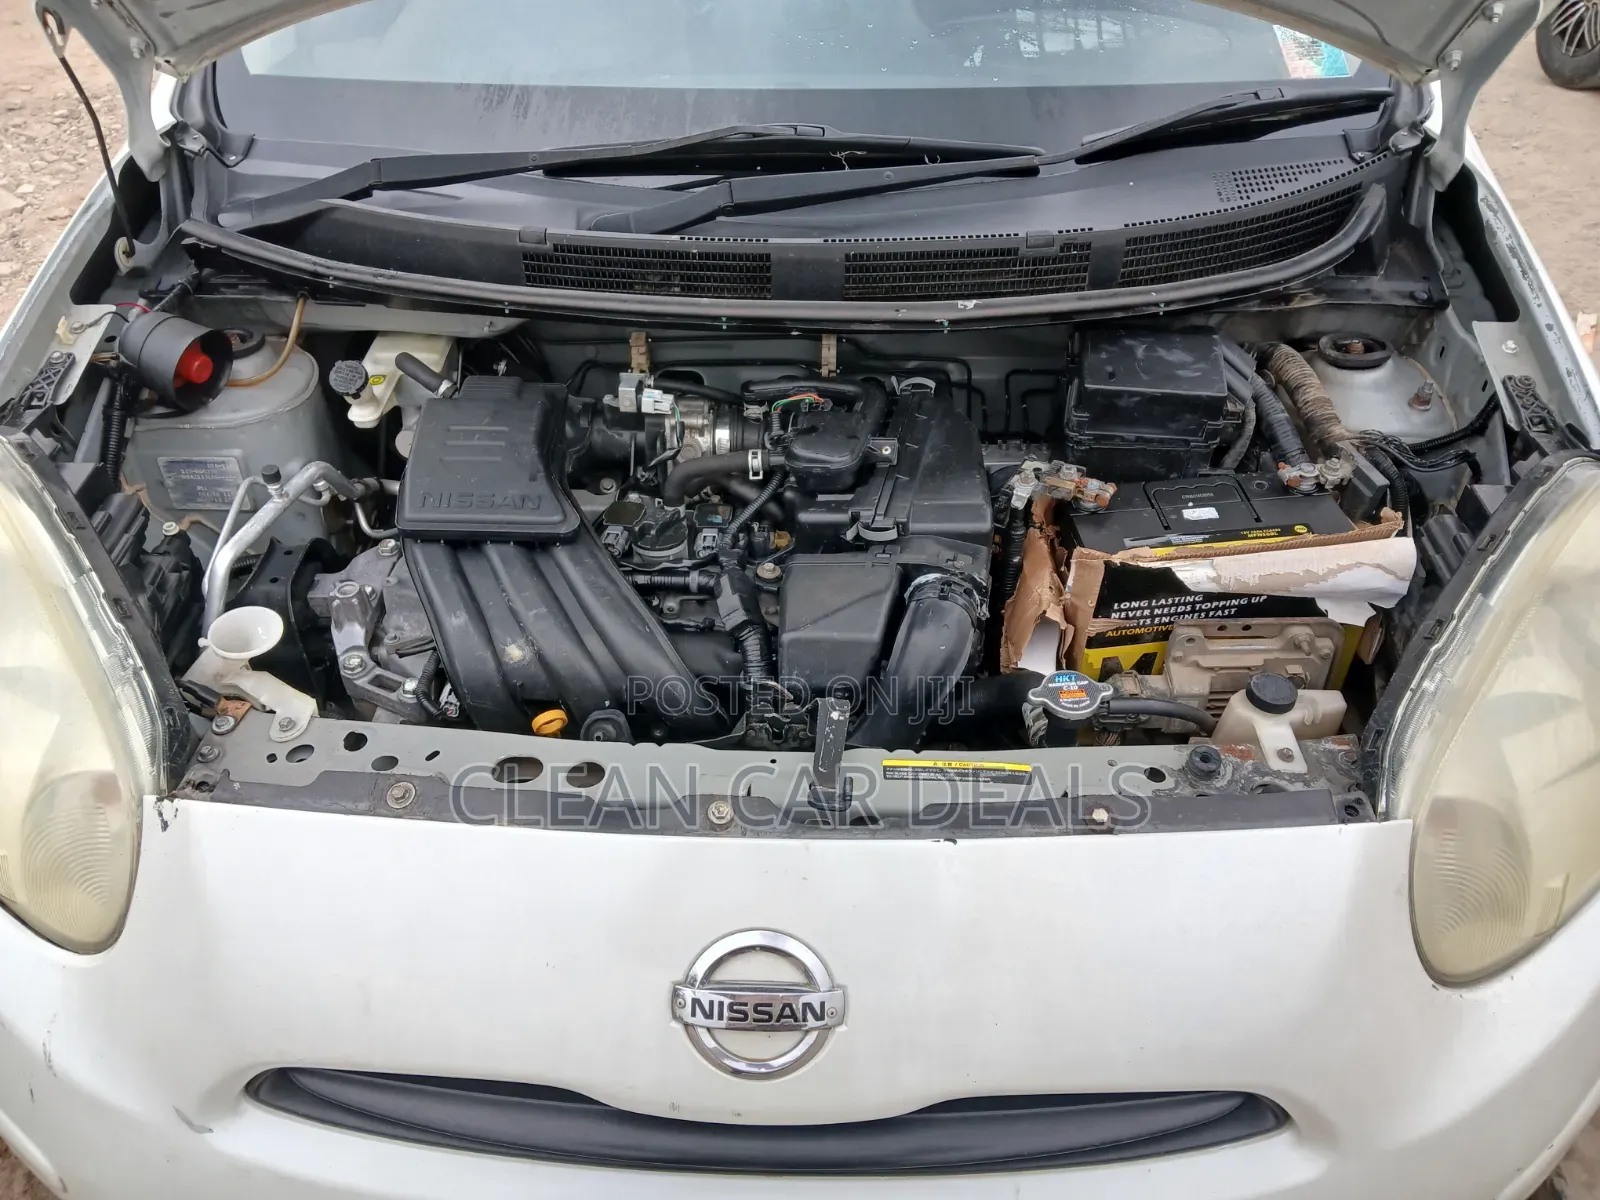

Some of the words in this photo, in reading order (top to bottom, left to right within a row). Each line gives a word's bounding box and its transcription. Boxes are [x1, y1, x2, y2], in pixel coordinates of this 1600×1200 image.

[420, 492, 542, 510] NISSAN
[1111, 607, 1151, 619] NEVER
[1153, 604, 1192, 615] NEEDS
[1195, 597, 1248, 610] TOPPING
[1251, 595, 1268, 604] UP
[1113, 600, 1149, 610] LONG
[1151, 594, 1204, 607] LASTING
[1154, 612, 1206, 625] ENGINES
[1208, 608, 1238, 617] FAST
[1105, 624, 1174, 637] AUTOMOTIVE
[1055, 674, 1077, 682] HKT
[690, 997, 826, 1024] NISSAN
